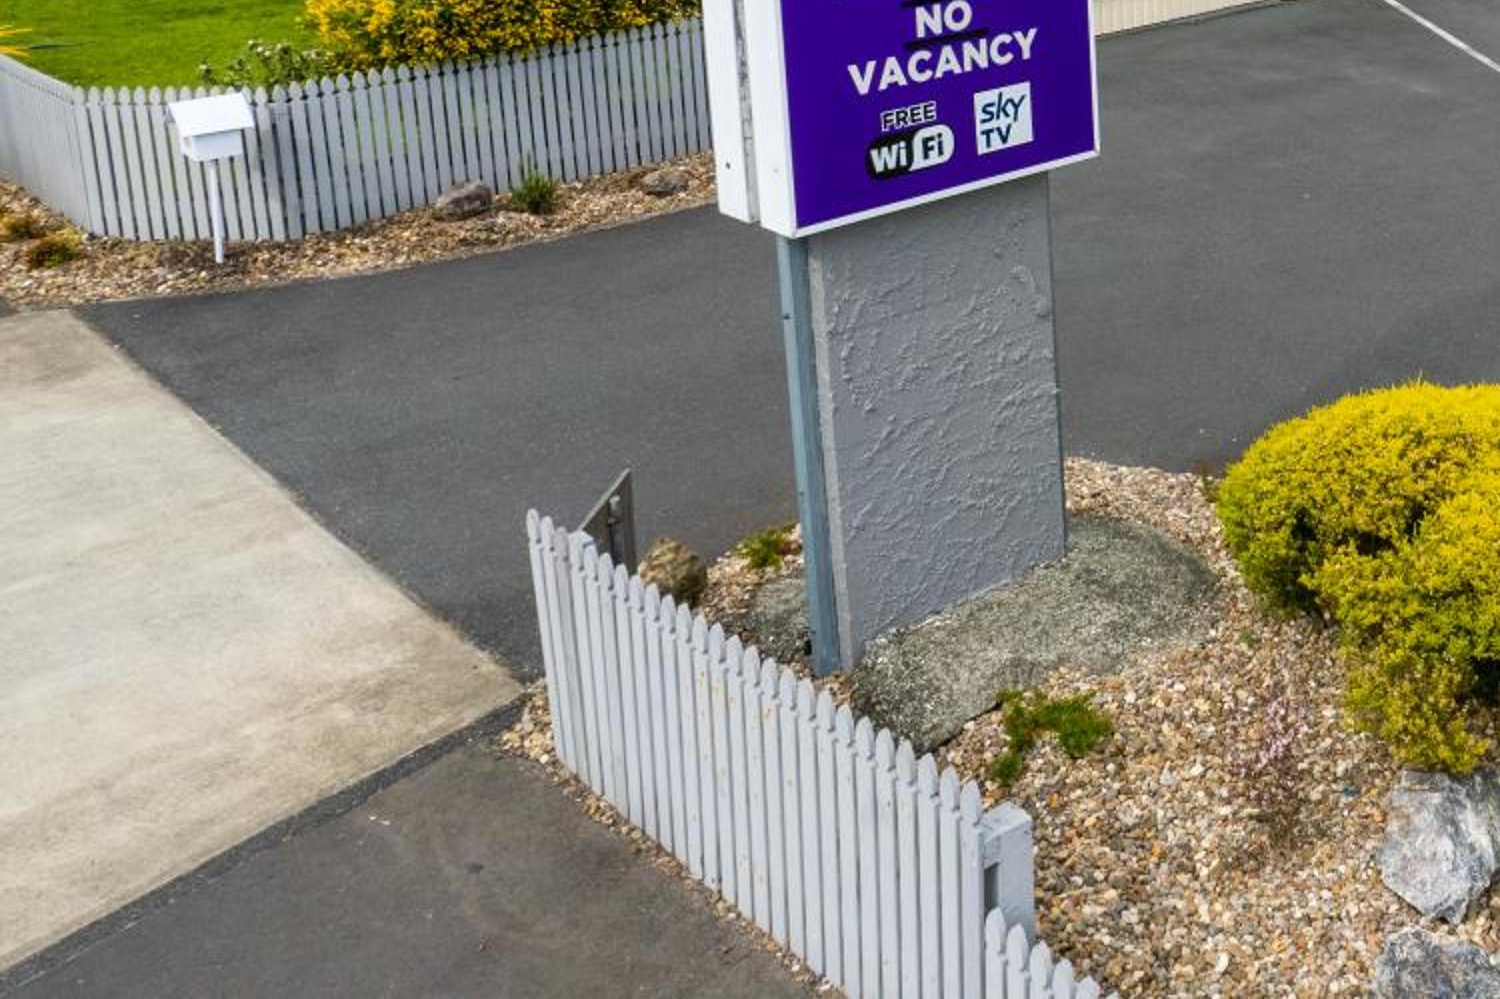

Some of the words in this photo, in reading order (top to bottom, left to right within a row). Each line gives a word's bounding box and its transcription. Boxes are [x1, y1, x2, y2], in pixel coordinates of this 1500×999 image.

[847, 28, 1038, 96] VACANCY
[881, 101, 937, 131] FREE
[980, 124, 1013, 149] TV
